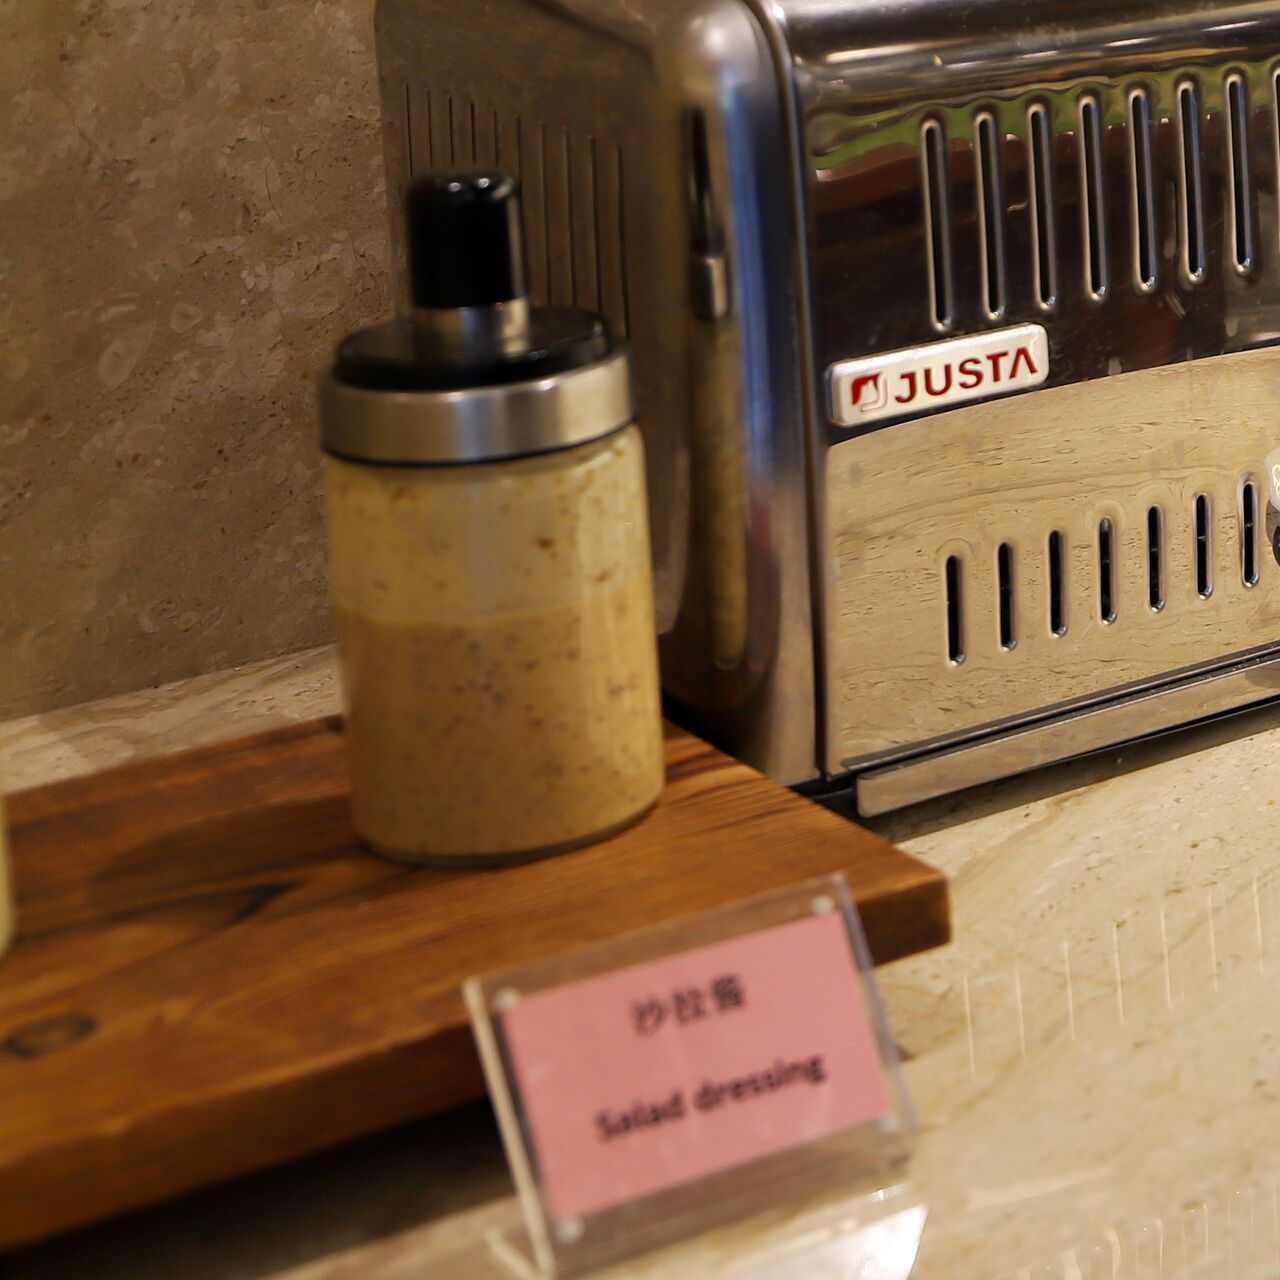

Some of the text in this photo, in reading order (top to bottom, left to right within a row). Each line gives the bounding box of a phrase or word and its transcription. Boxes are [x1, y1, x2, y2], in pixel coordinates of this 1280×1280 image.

[895, 346, 1038, 404] JUSTA
[631, 974, 747, 1036] 沙拉酱
[593, 1053, 827, 1142] Salad dressing
